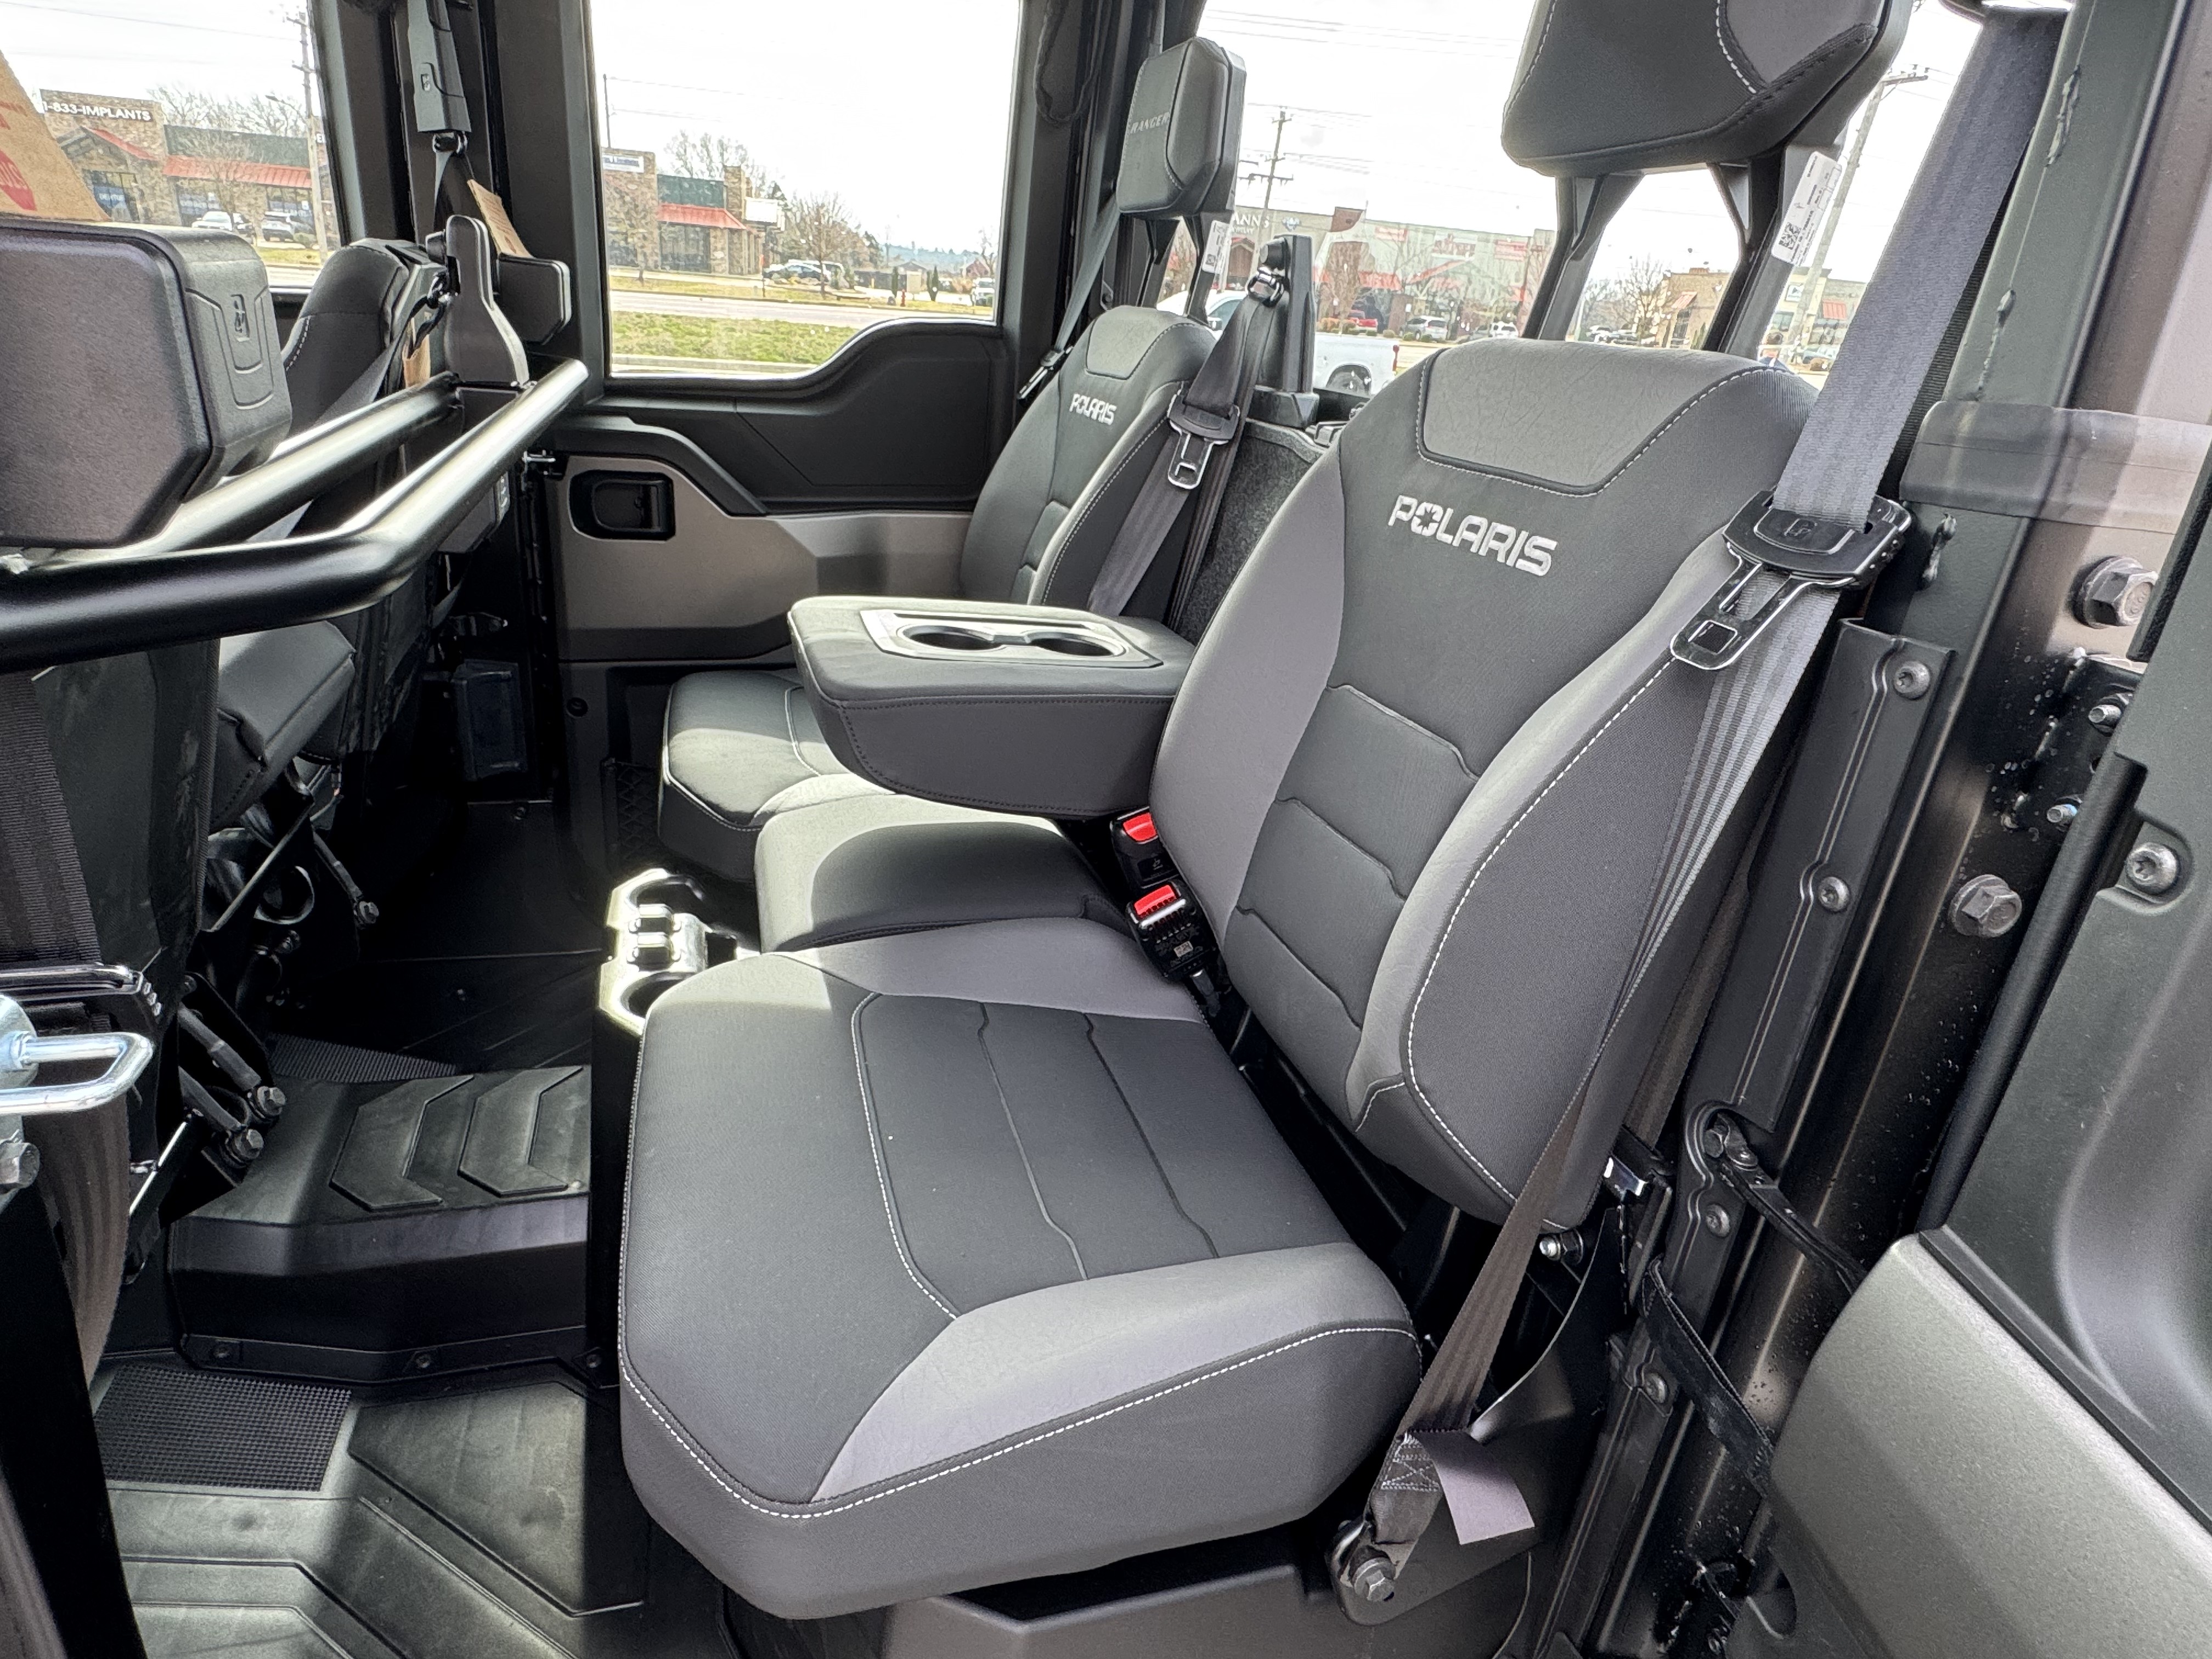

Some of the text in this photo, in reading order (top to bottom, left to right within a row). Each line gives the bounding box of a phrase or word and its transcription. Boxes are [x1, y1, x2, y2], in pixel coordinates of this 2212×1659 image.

[43, 101, 151, 121] 1-833-IMPLANTS
[1130, 112, 1170, 134] RANGER
[1069, 393, 1117, 425] POLARIS
[1388, 495, 1558, 576] POLARIS
